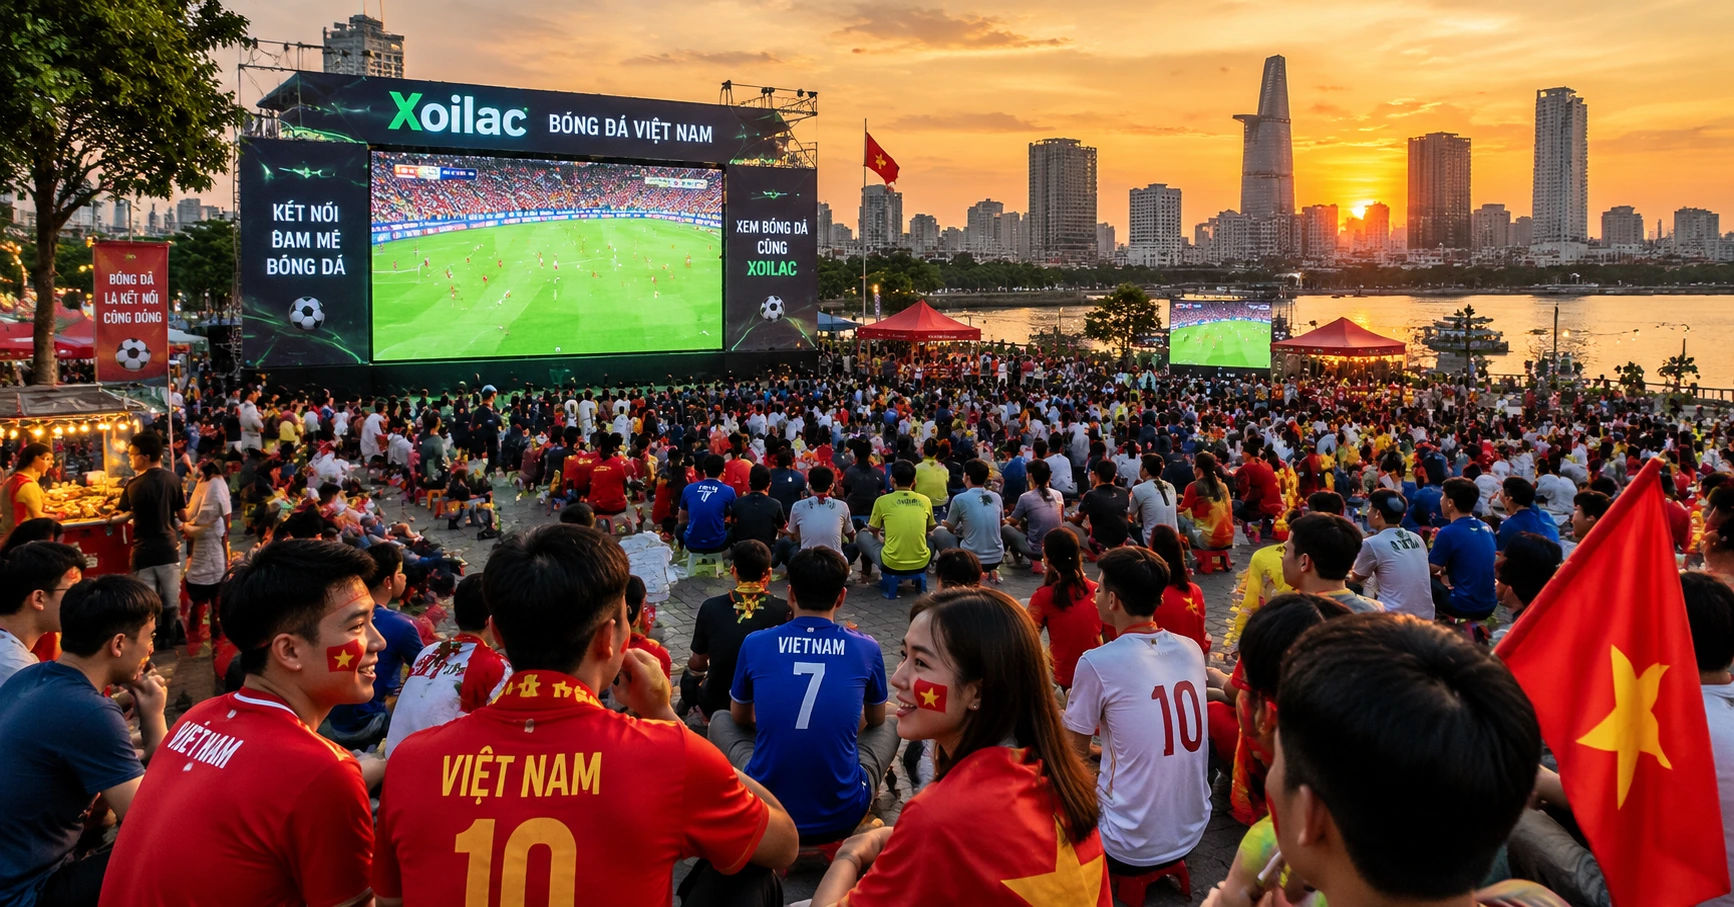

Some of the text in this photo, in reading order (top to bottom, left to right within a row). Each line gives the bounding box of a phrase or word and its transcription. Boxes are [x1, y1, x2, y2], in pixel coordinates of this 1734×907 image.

[387, 90, 528, 137] Xoilac
[633, 116, 672, 144] VIỆT
[676, 123, 713, 143] NAM
[736, 219, 759, 234] XEM
[266, 254, 316, 275] BÓNG
[746, 260, 798, 276] XOILAC
[778, 636, 846, 655] VIETNAM
[793, 661, 826, 729] 7
[1151, 680, 1203, 756] 10
[442, 745, 602, 805] VIỆT NAM
[454, 817, 577, 907] 10
